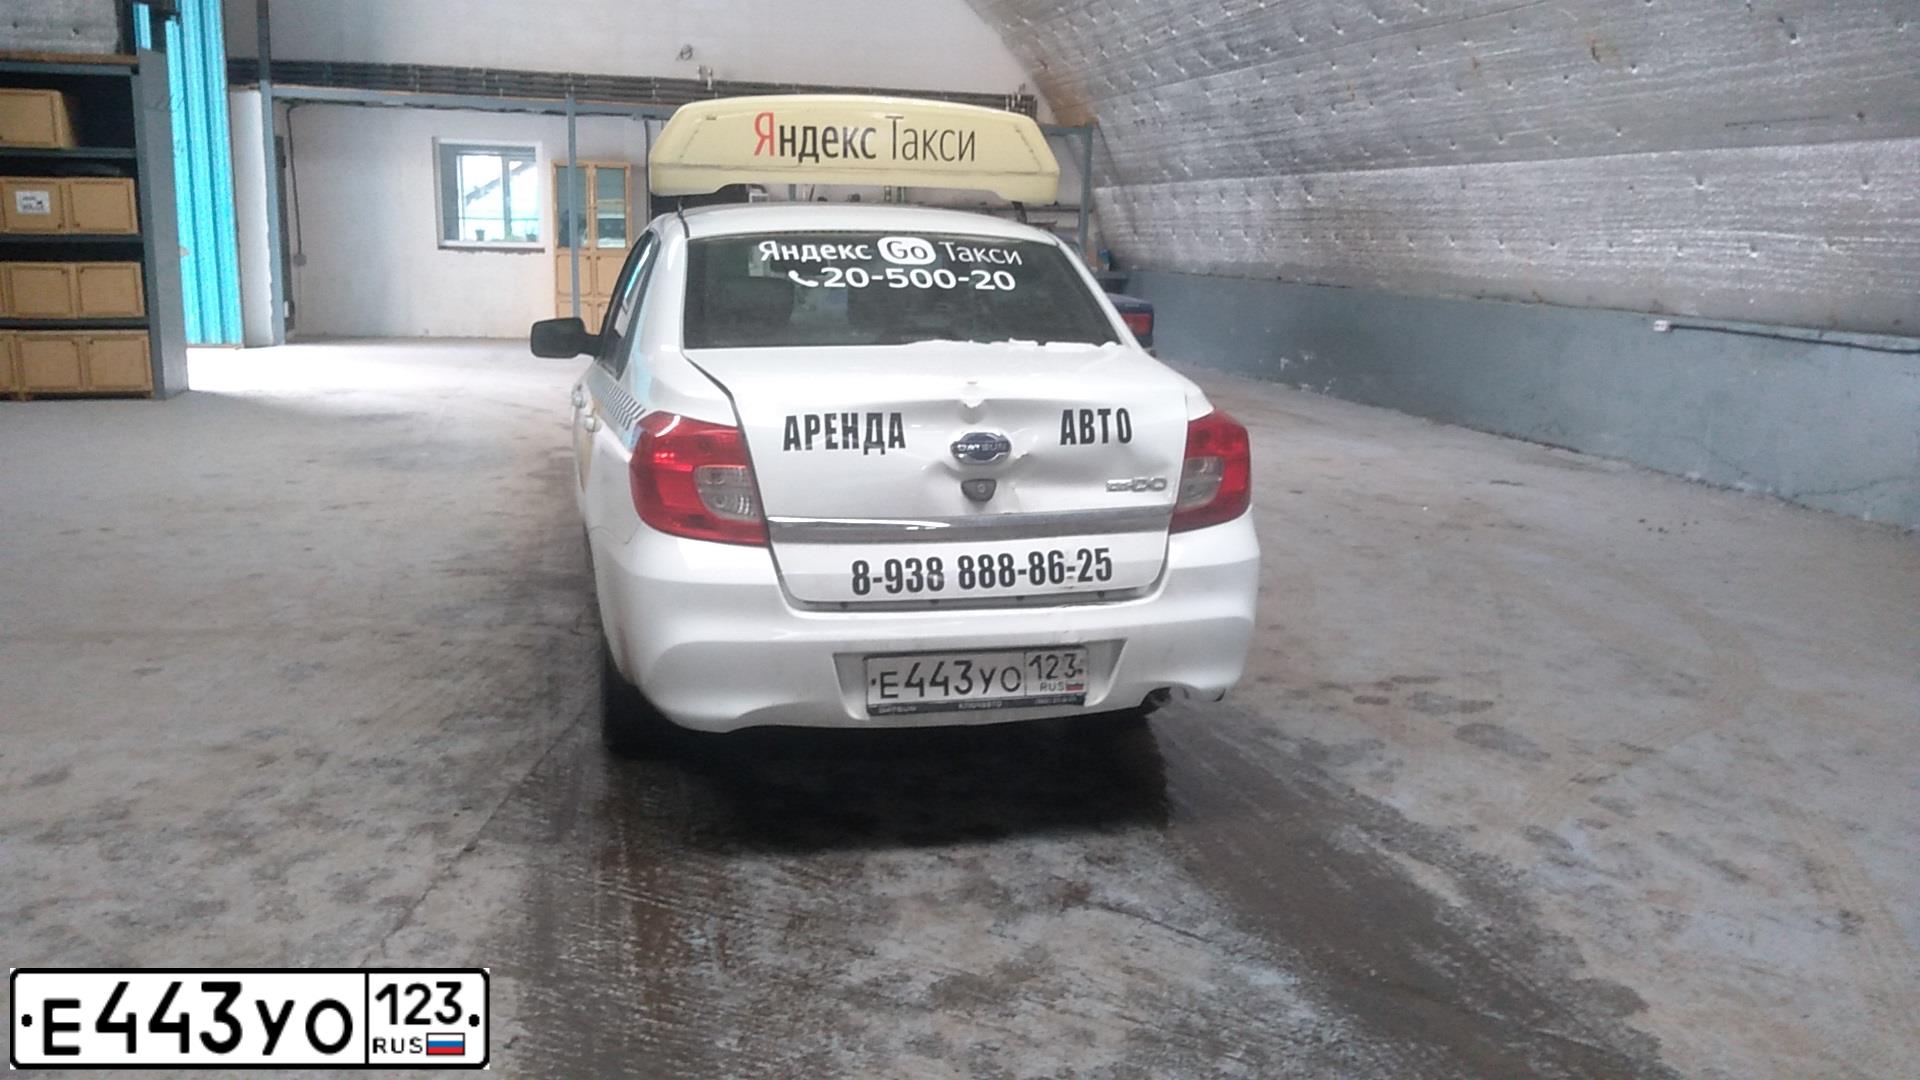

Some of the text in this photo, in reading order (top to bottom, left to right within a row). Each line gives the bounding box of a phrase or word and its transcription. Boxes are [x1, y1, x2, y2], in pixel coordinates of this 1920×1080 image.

[753, 111, 976, 164] Яндекс Такси
[758, 238, 1023, 266] Яндекс Go Такси
[819, 267, 1016, 291] 20-500-20
[783, 408, 1132, 456] АРЕНДА АВТО
[851, 547, 1113, 596] 8-938 888-86-25
[880, 652, 1078, 699] Е443УО 123
[1039, 680, 1065, 692] RUS
